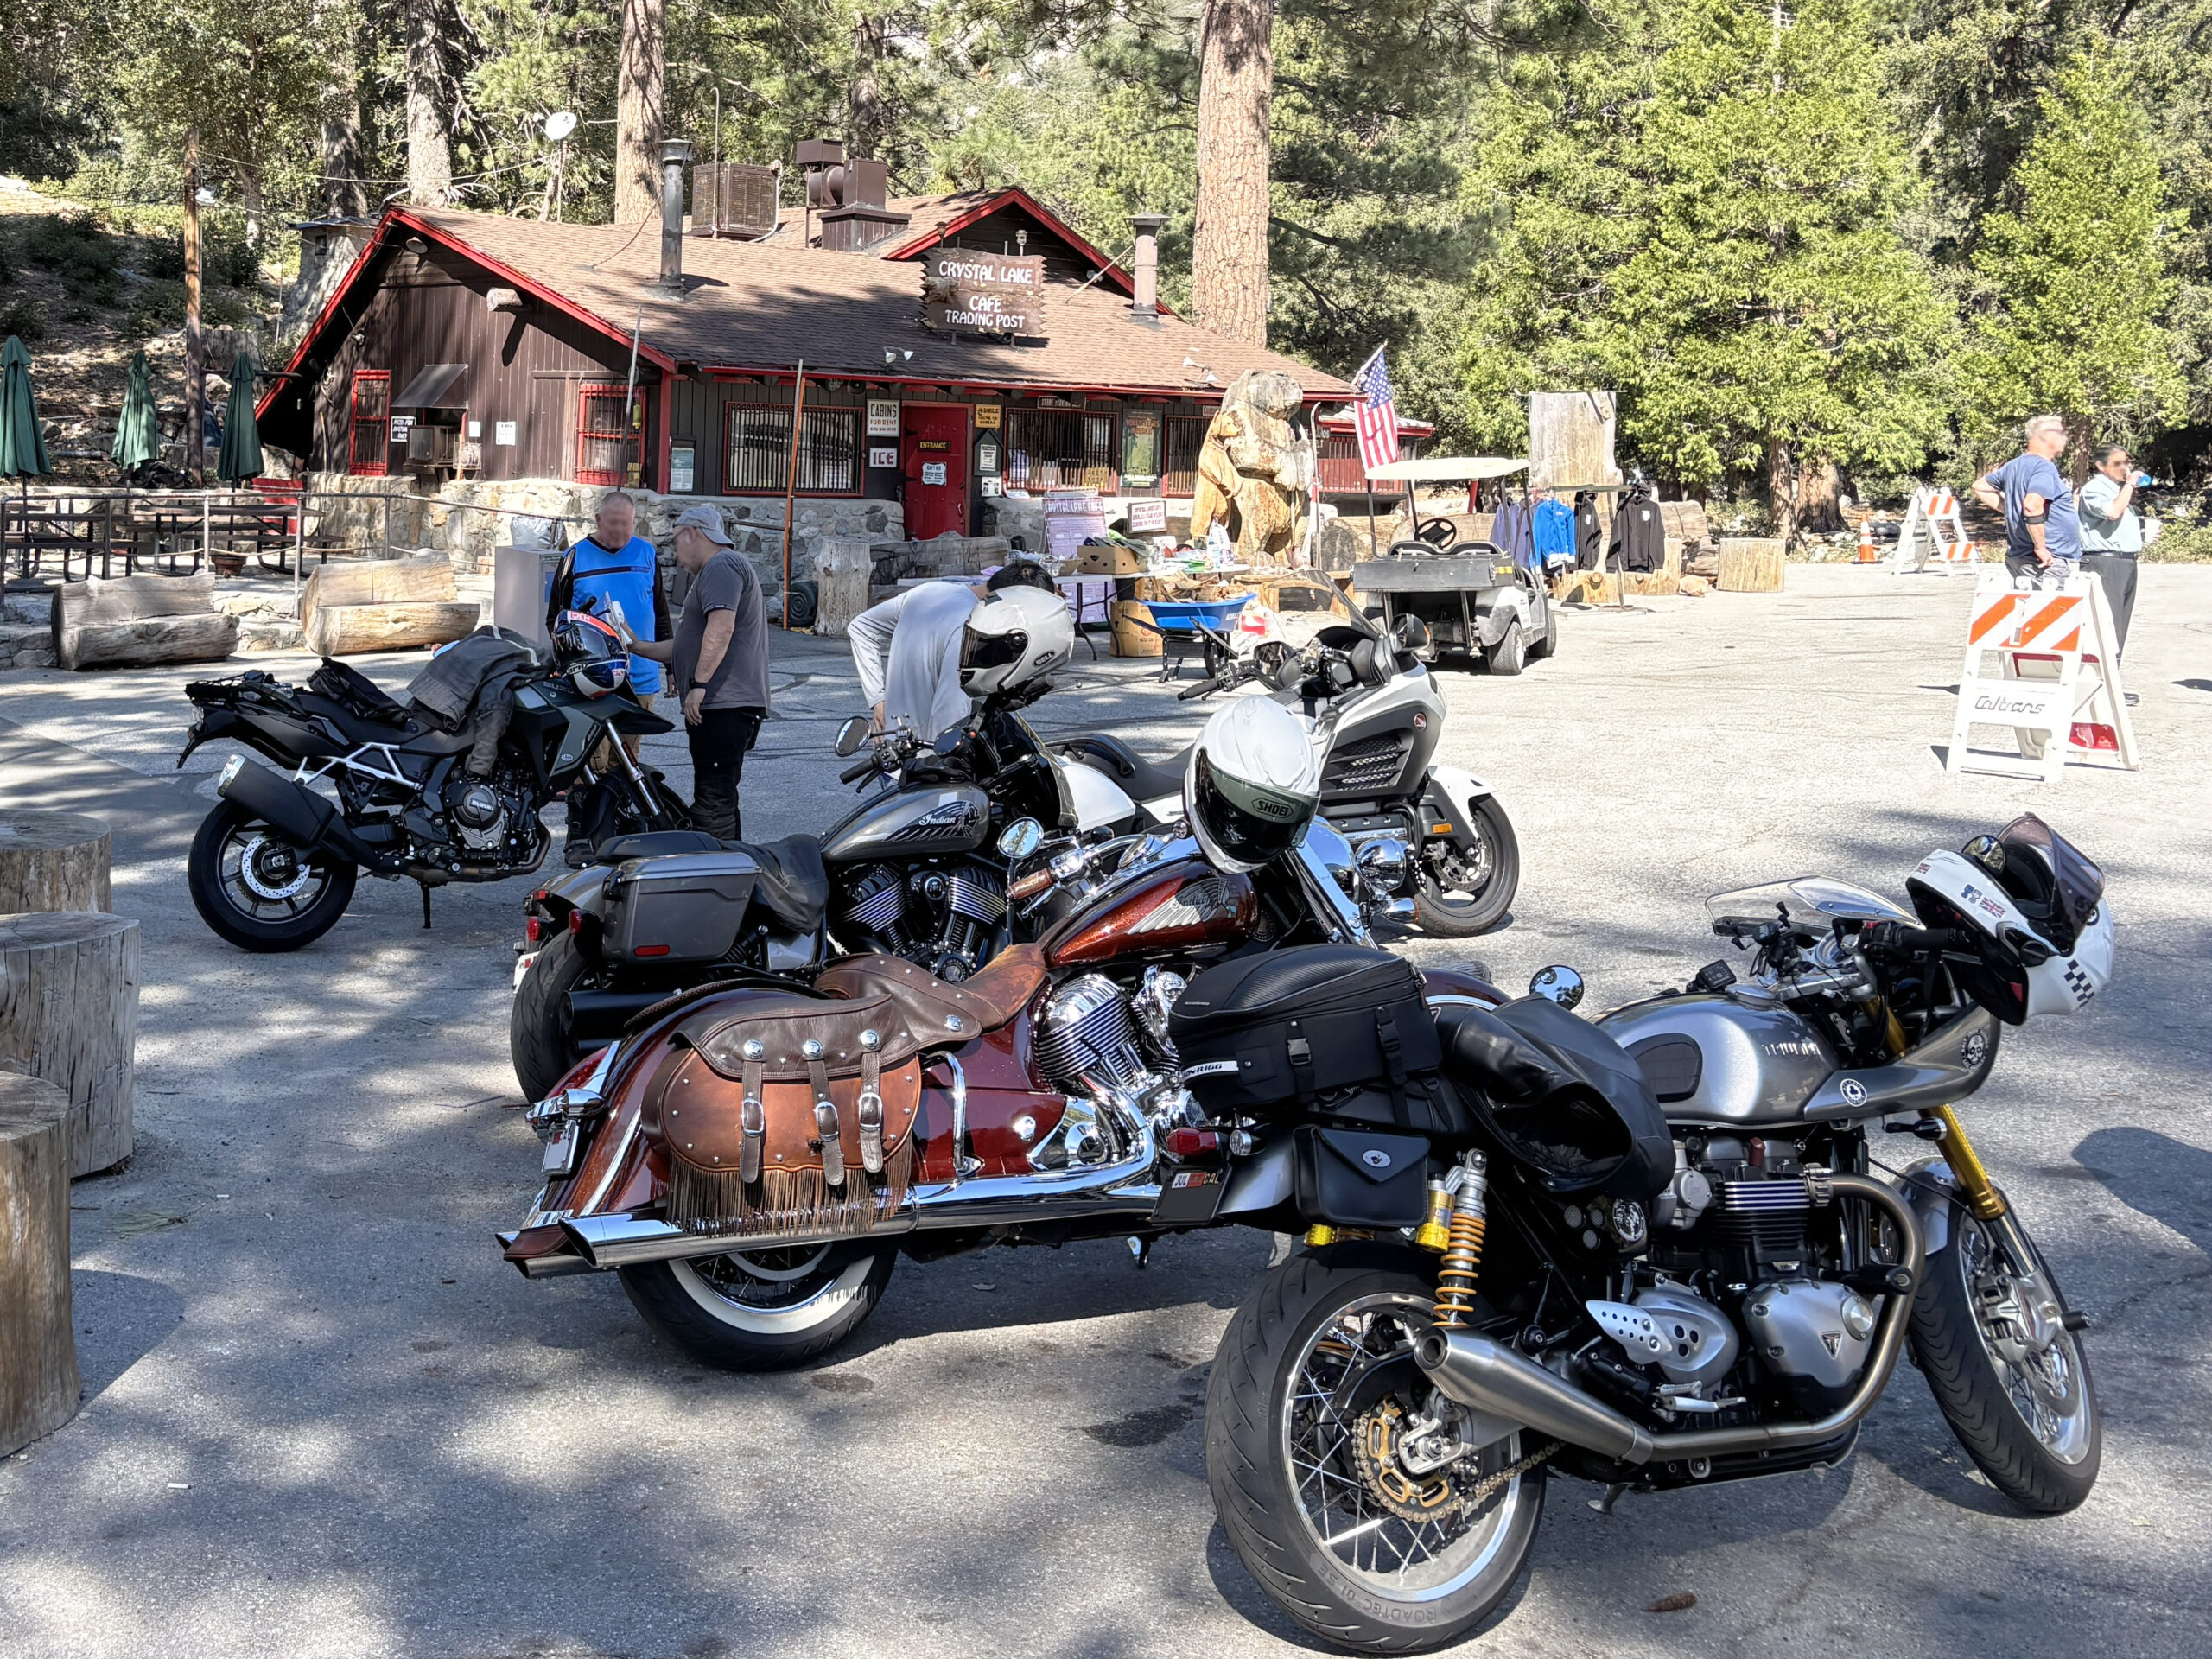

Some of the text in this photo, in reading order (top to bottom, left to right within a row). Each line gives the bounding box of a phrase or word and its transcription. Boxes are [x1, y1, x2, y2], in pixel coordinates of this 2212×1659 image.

[938, 260, 1033, 284] CRYSTAL LAKE
[969, 296, 1001, 313] CAFE
[945, 309, 1025, 328] TRADING POST
[870, 404, 897, 418] CABINS
[873, 452, 894, 465] ICE
[1045, 501, 1071, 512] CRYSTAL
[1036, 652, 1054, 665] BELL
[1974, 696, 2046, 714] Caltrans
[1257, 800, 1289, 817] SHOEI
[918, 814, 956, 826] Indian
[1172, 893, 1211, 910] Indian
[1318, 1564, 1339, 1586] SE
[1363, 1599, 1438, 1624] ROADTEC
